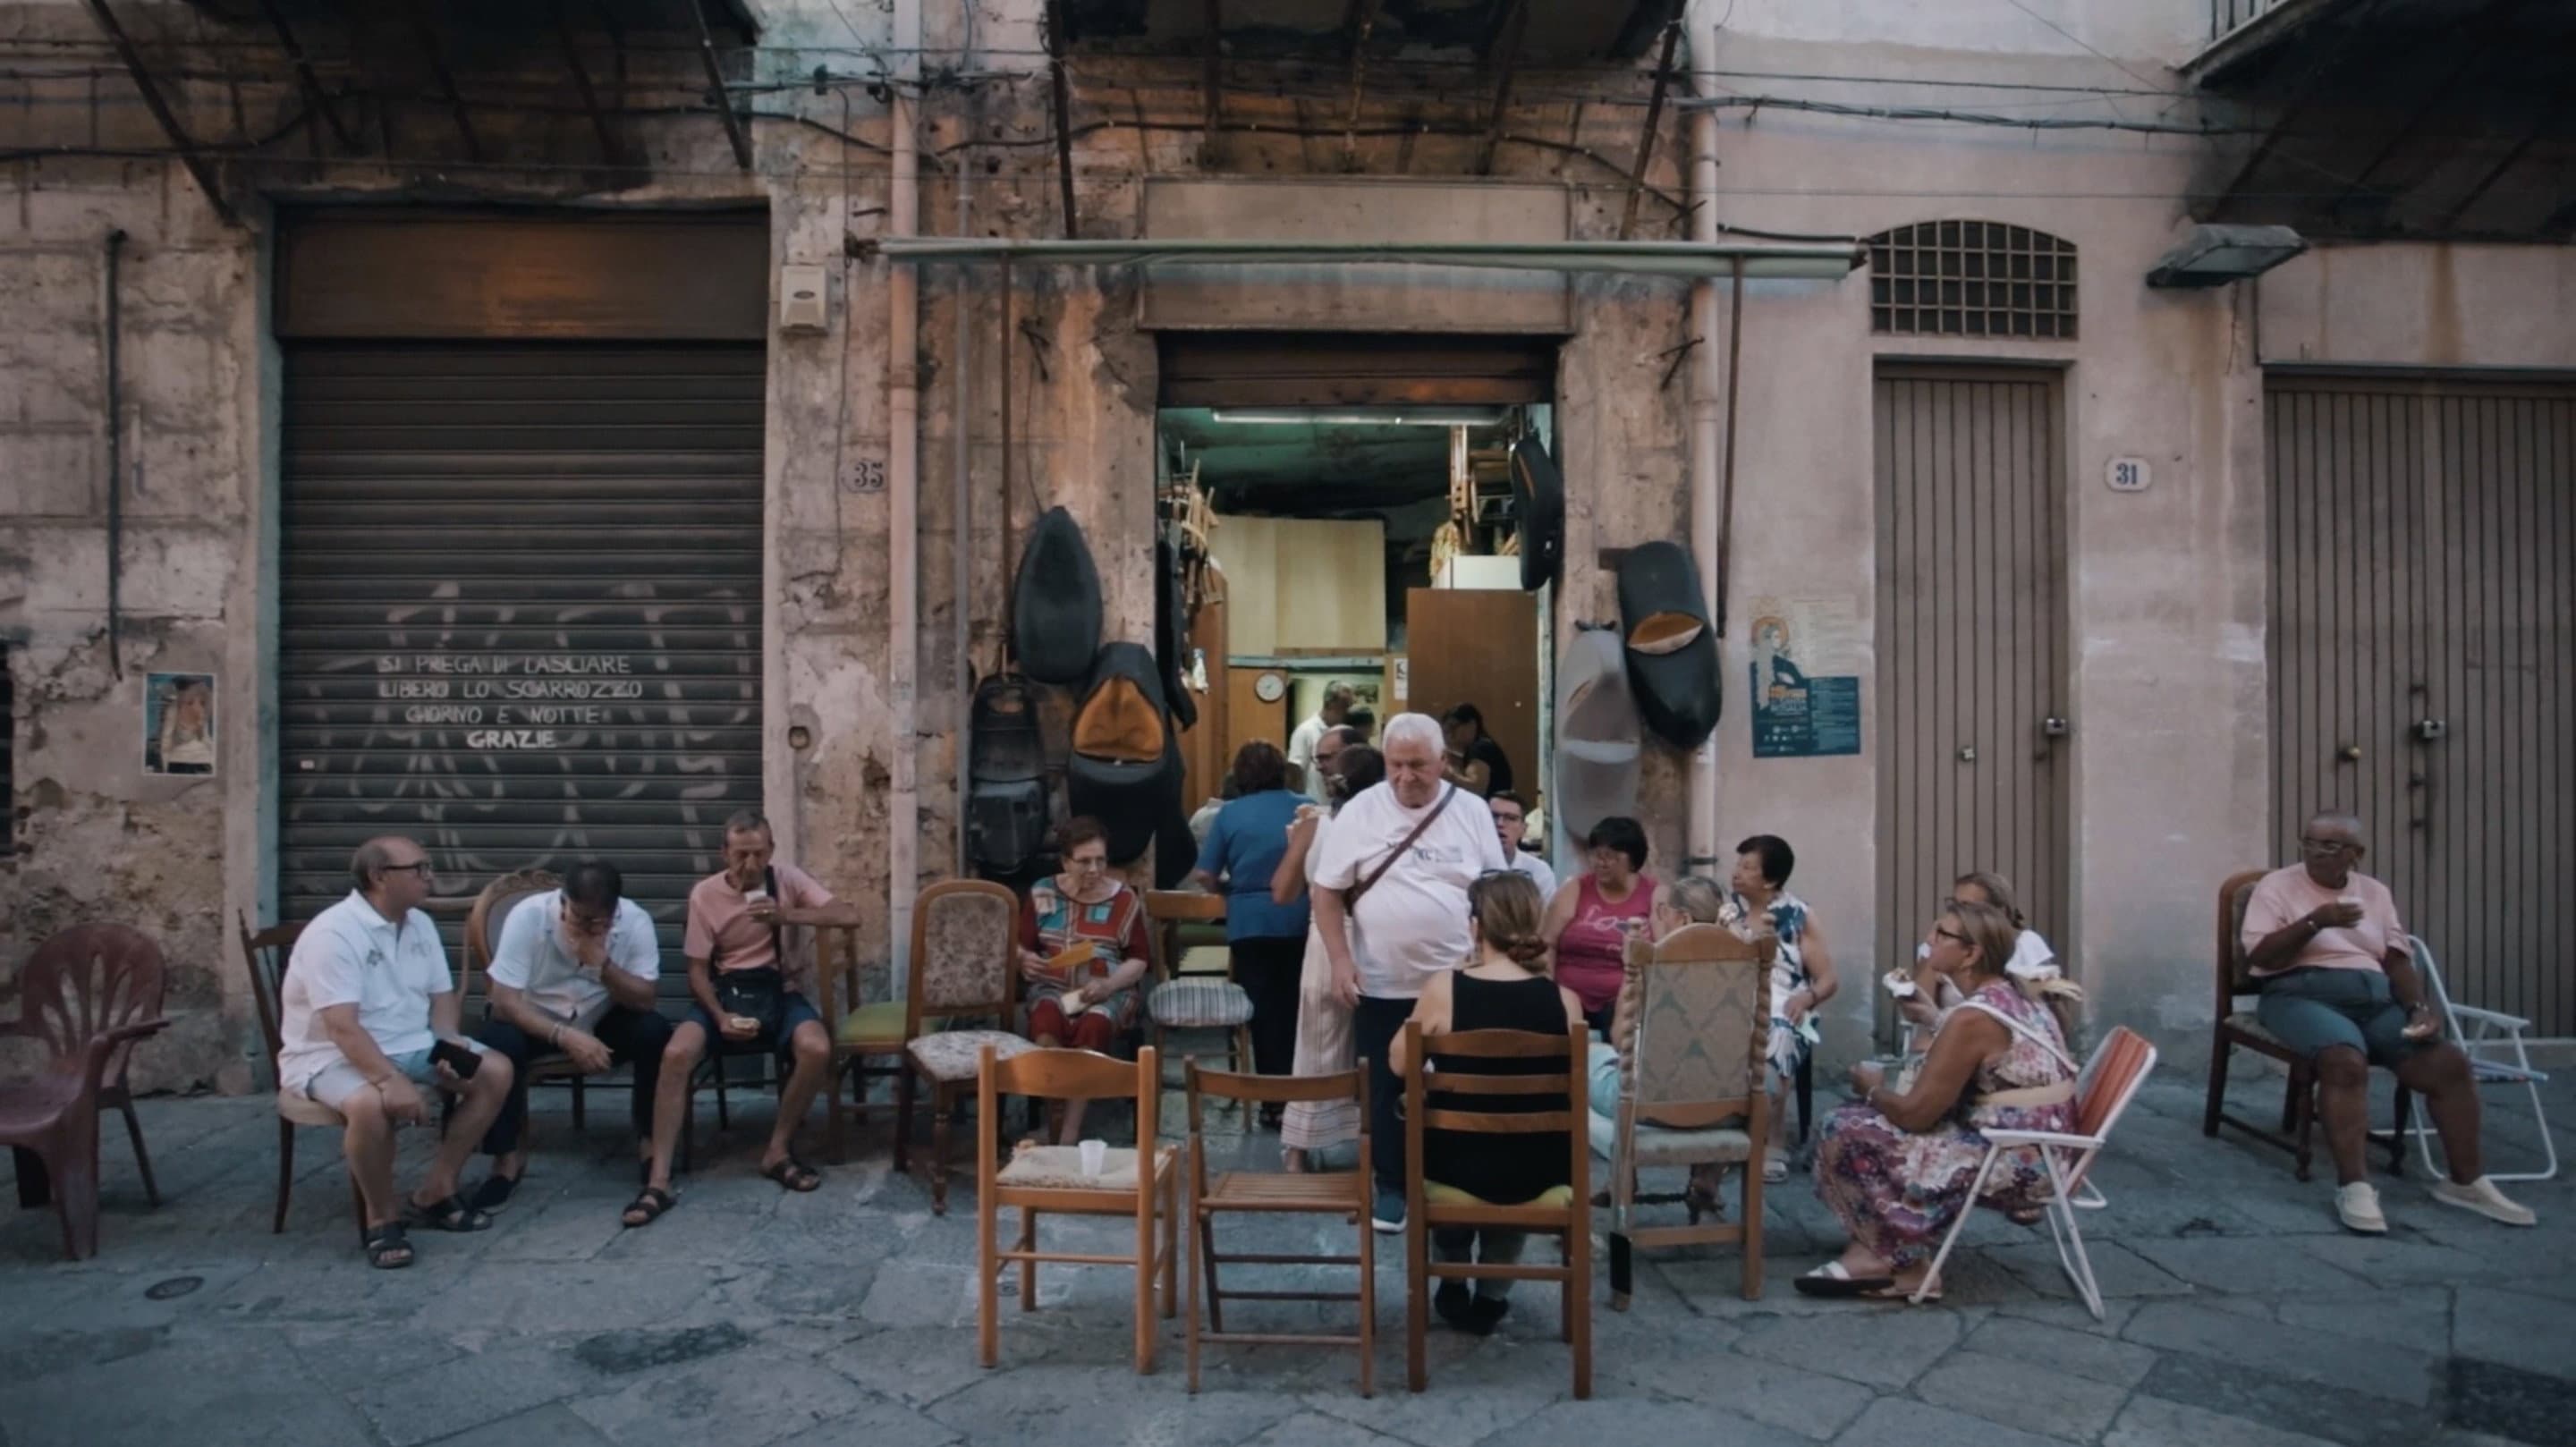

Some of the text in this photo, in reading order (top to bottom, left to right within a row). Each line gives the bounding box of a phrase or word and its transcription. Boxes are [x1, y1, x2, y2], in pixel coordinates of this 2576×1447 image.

[854, 461, 884, 487] 35
[2115, 462, 2138, 486] 31
[377, 655, 631, 673] SI PREGA DI LASCIARE
[378, 680, 642, 698] LIBERO LO SCARROZZO
[405, 705, 601, 724] GIORNO E NOTTE
[466, 730, 557, 749] GRAZIE
